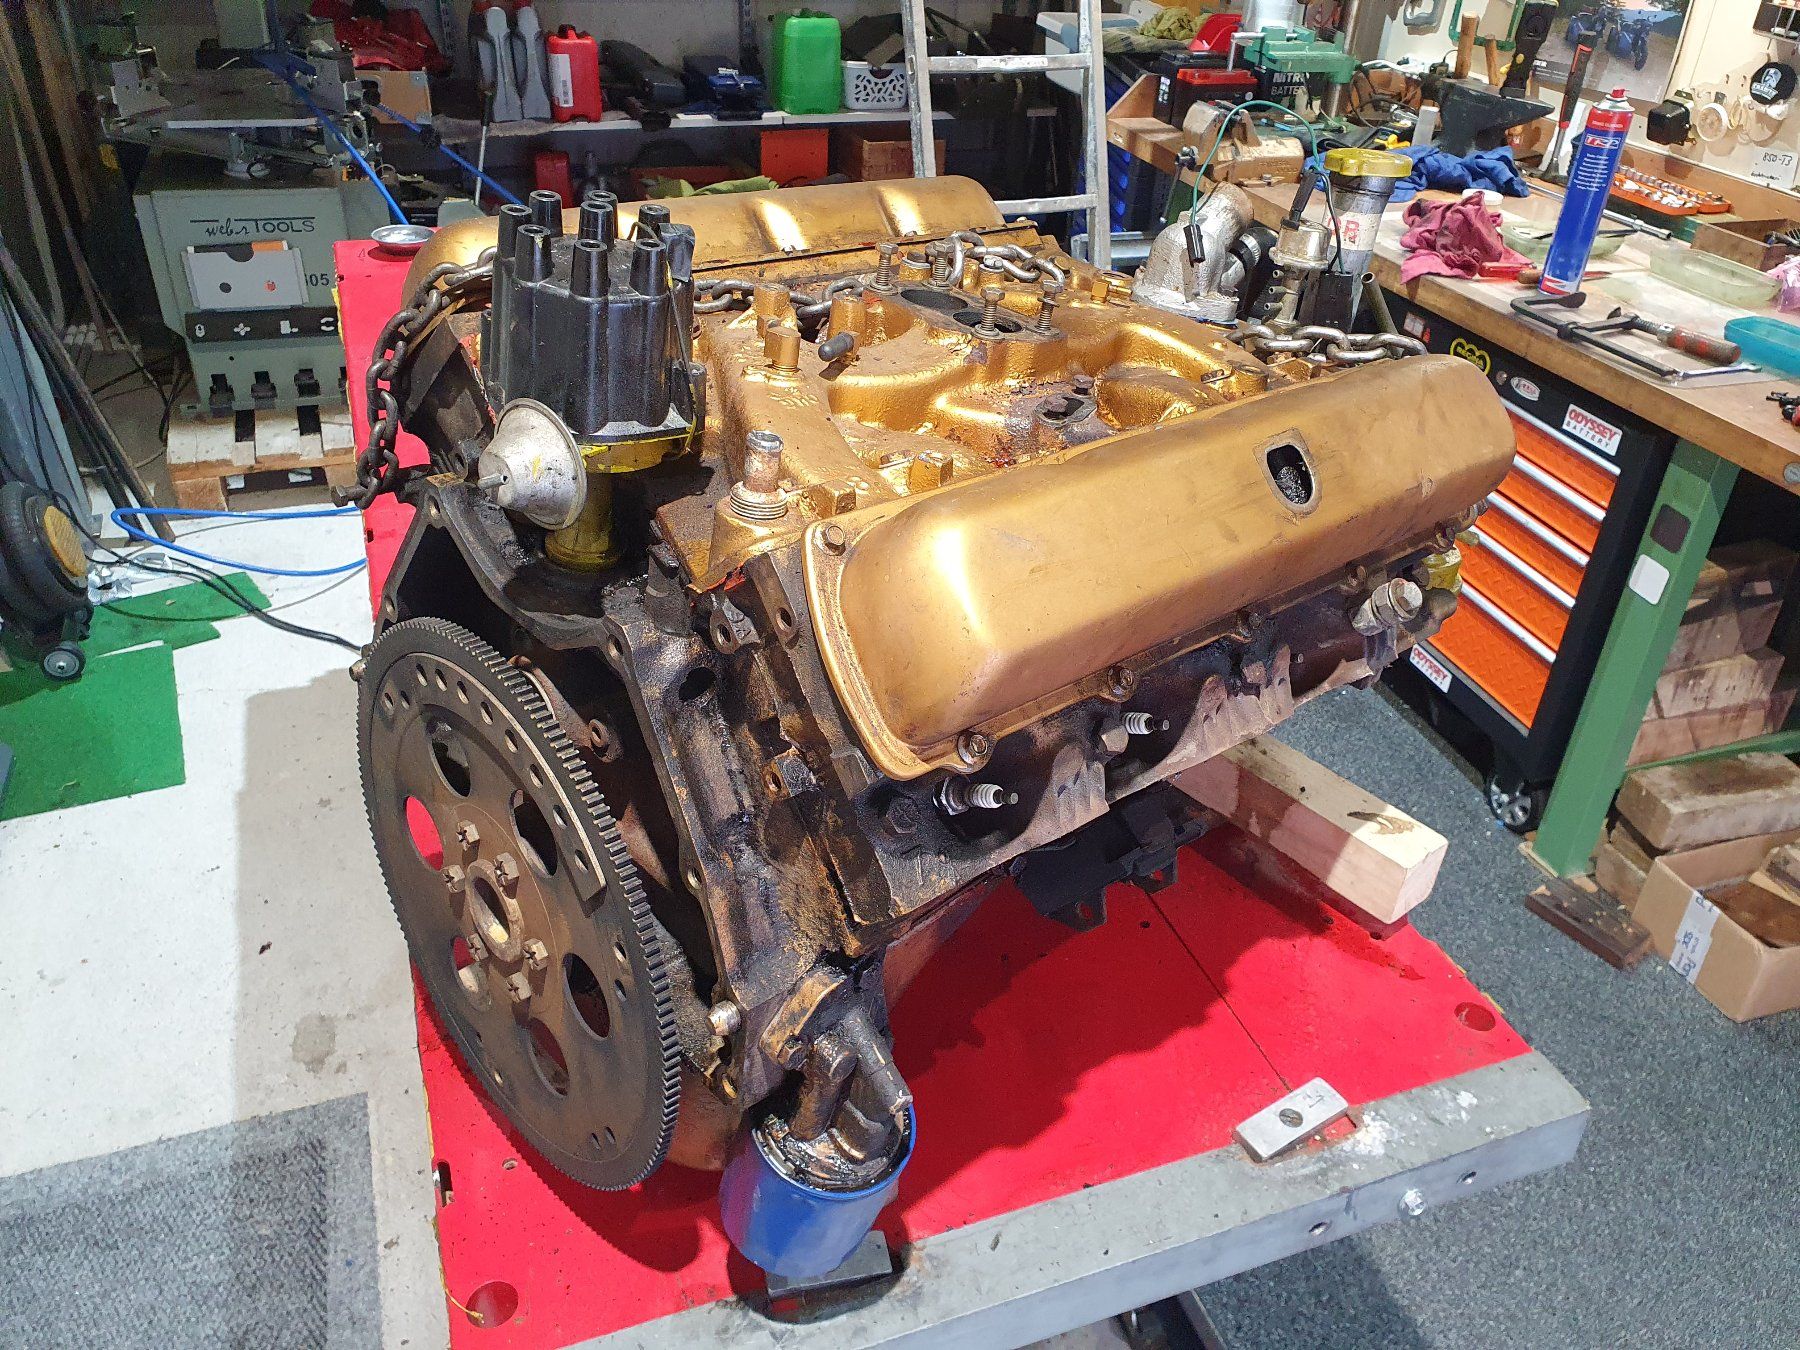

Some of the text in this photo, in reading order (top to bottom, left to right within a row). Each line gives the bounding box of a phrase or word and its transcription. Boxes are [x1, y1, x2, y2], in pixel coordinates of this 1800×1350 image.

[253, 217, 316, 233] TOOLS
[1566, 420, 1610, 448] BATTERY
[1569, 409, 1618, 441] ODYSSEY
